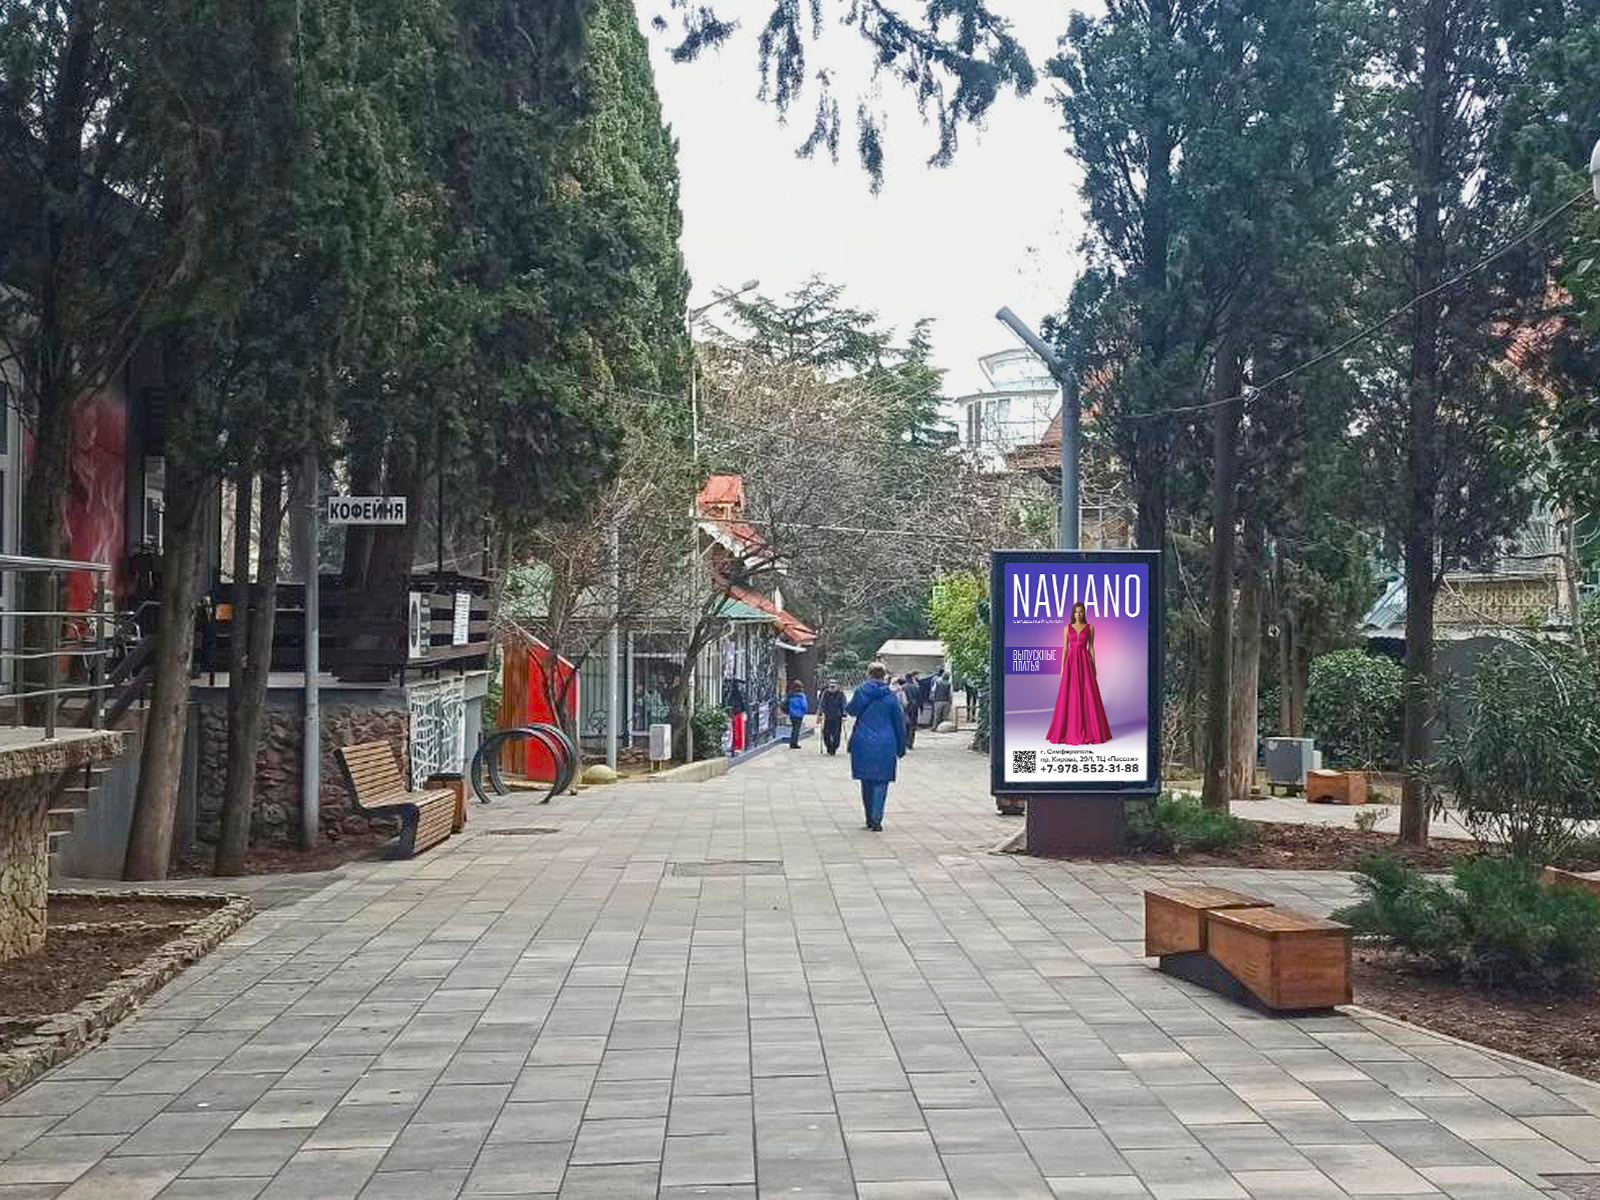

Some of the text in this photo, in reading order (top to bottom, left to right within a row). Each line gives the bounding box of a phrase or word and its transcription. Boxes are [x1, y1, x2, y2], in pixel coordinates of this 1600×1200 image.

[330, 499, 403, 519] КОФЕЙНЯ
[1013, 573, 1140, 618] NAVIANO
[1012, 649, 1057, 661] ВЫПУСКНЫЕ
[1012, 661, 1040, 672] ПЛАТЬЯ
[1040, 764, 1139, 773] +7-978-552-31-88
